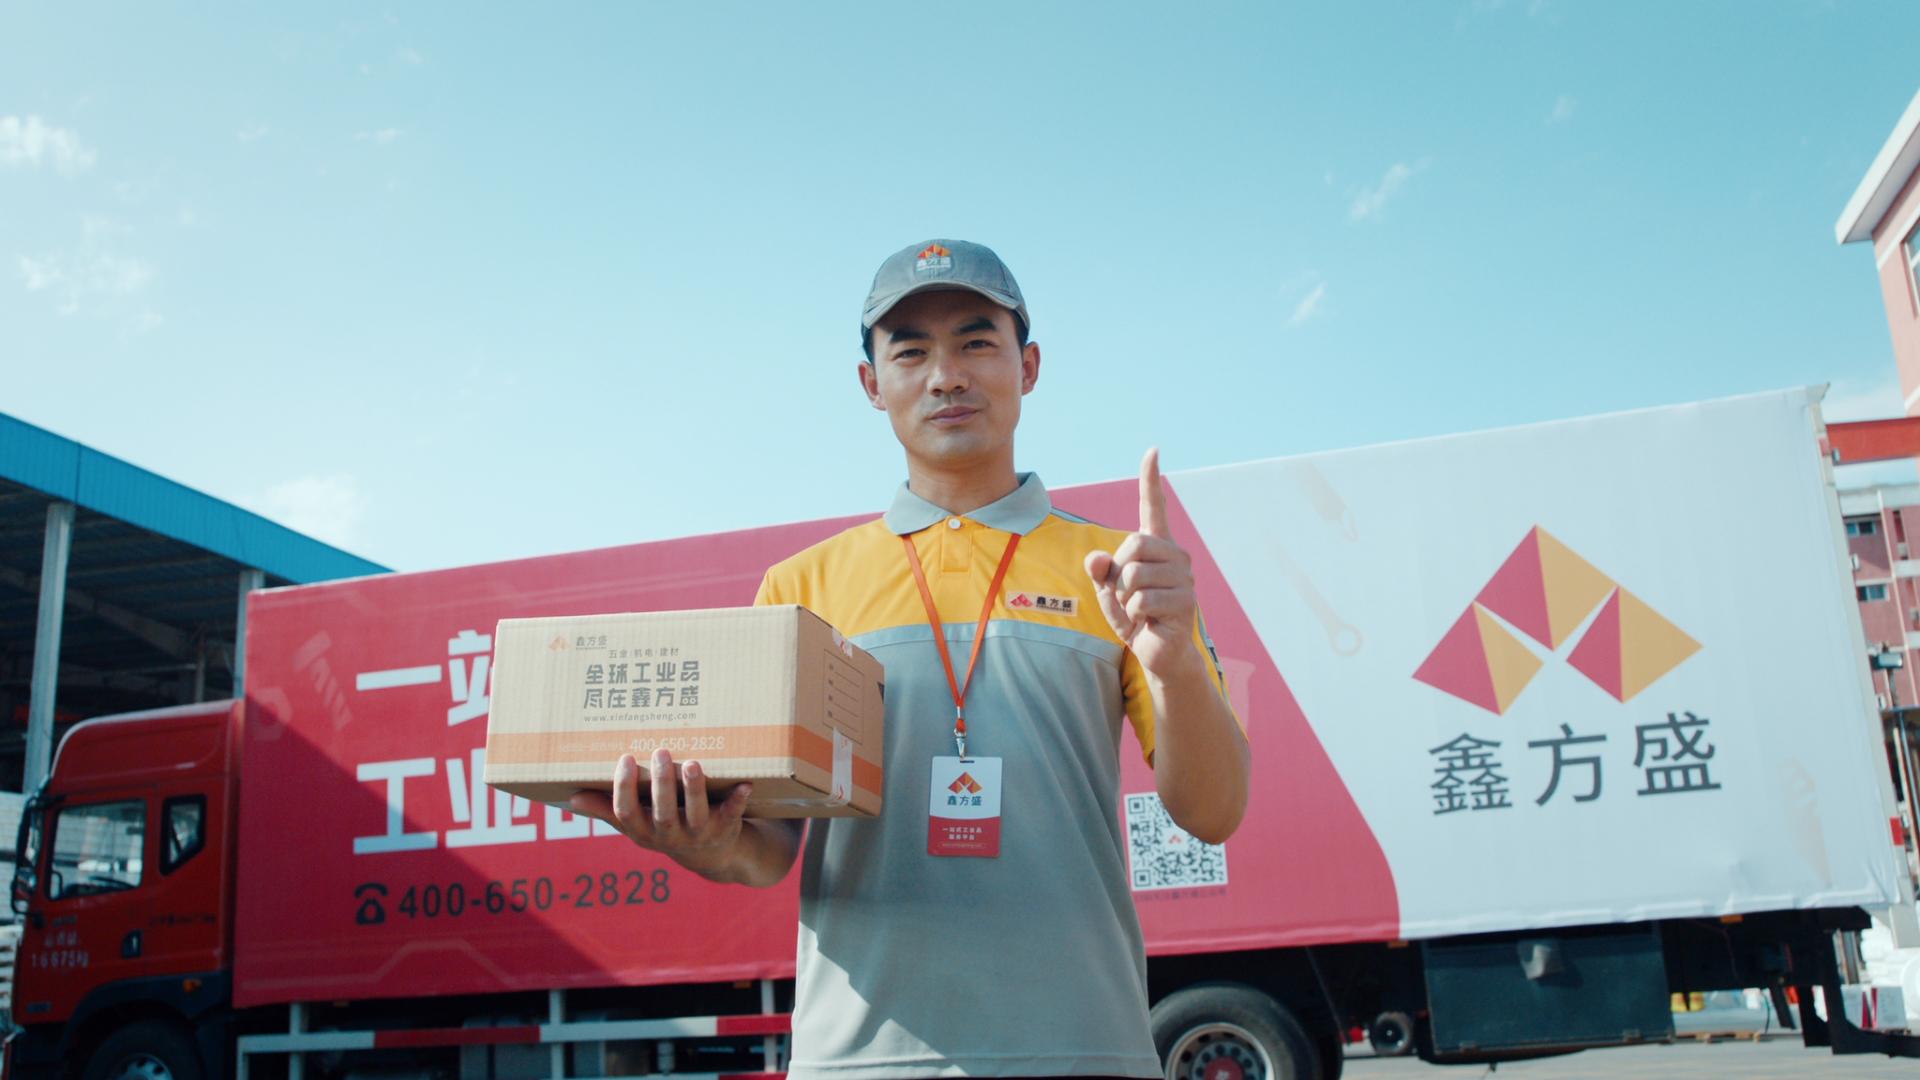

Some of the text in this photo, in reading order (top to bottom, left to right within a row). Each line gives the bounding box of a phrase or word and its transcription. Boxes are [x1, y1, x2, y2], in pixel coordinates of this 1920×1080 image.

[585, 661, 700, 685] 全球工业品
[583, 685, 700, 709] 尽在鑫方盛
[584, 711, 697, 723] www.xinfangsheng.com
[631, 736, 726, 752] 400-650-2828
[1428, 711, 1722, 816] 鑫方盛
[399, 868, 671, 919] 400-650-2828
